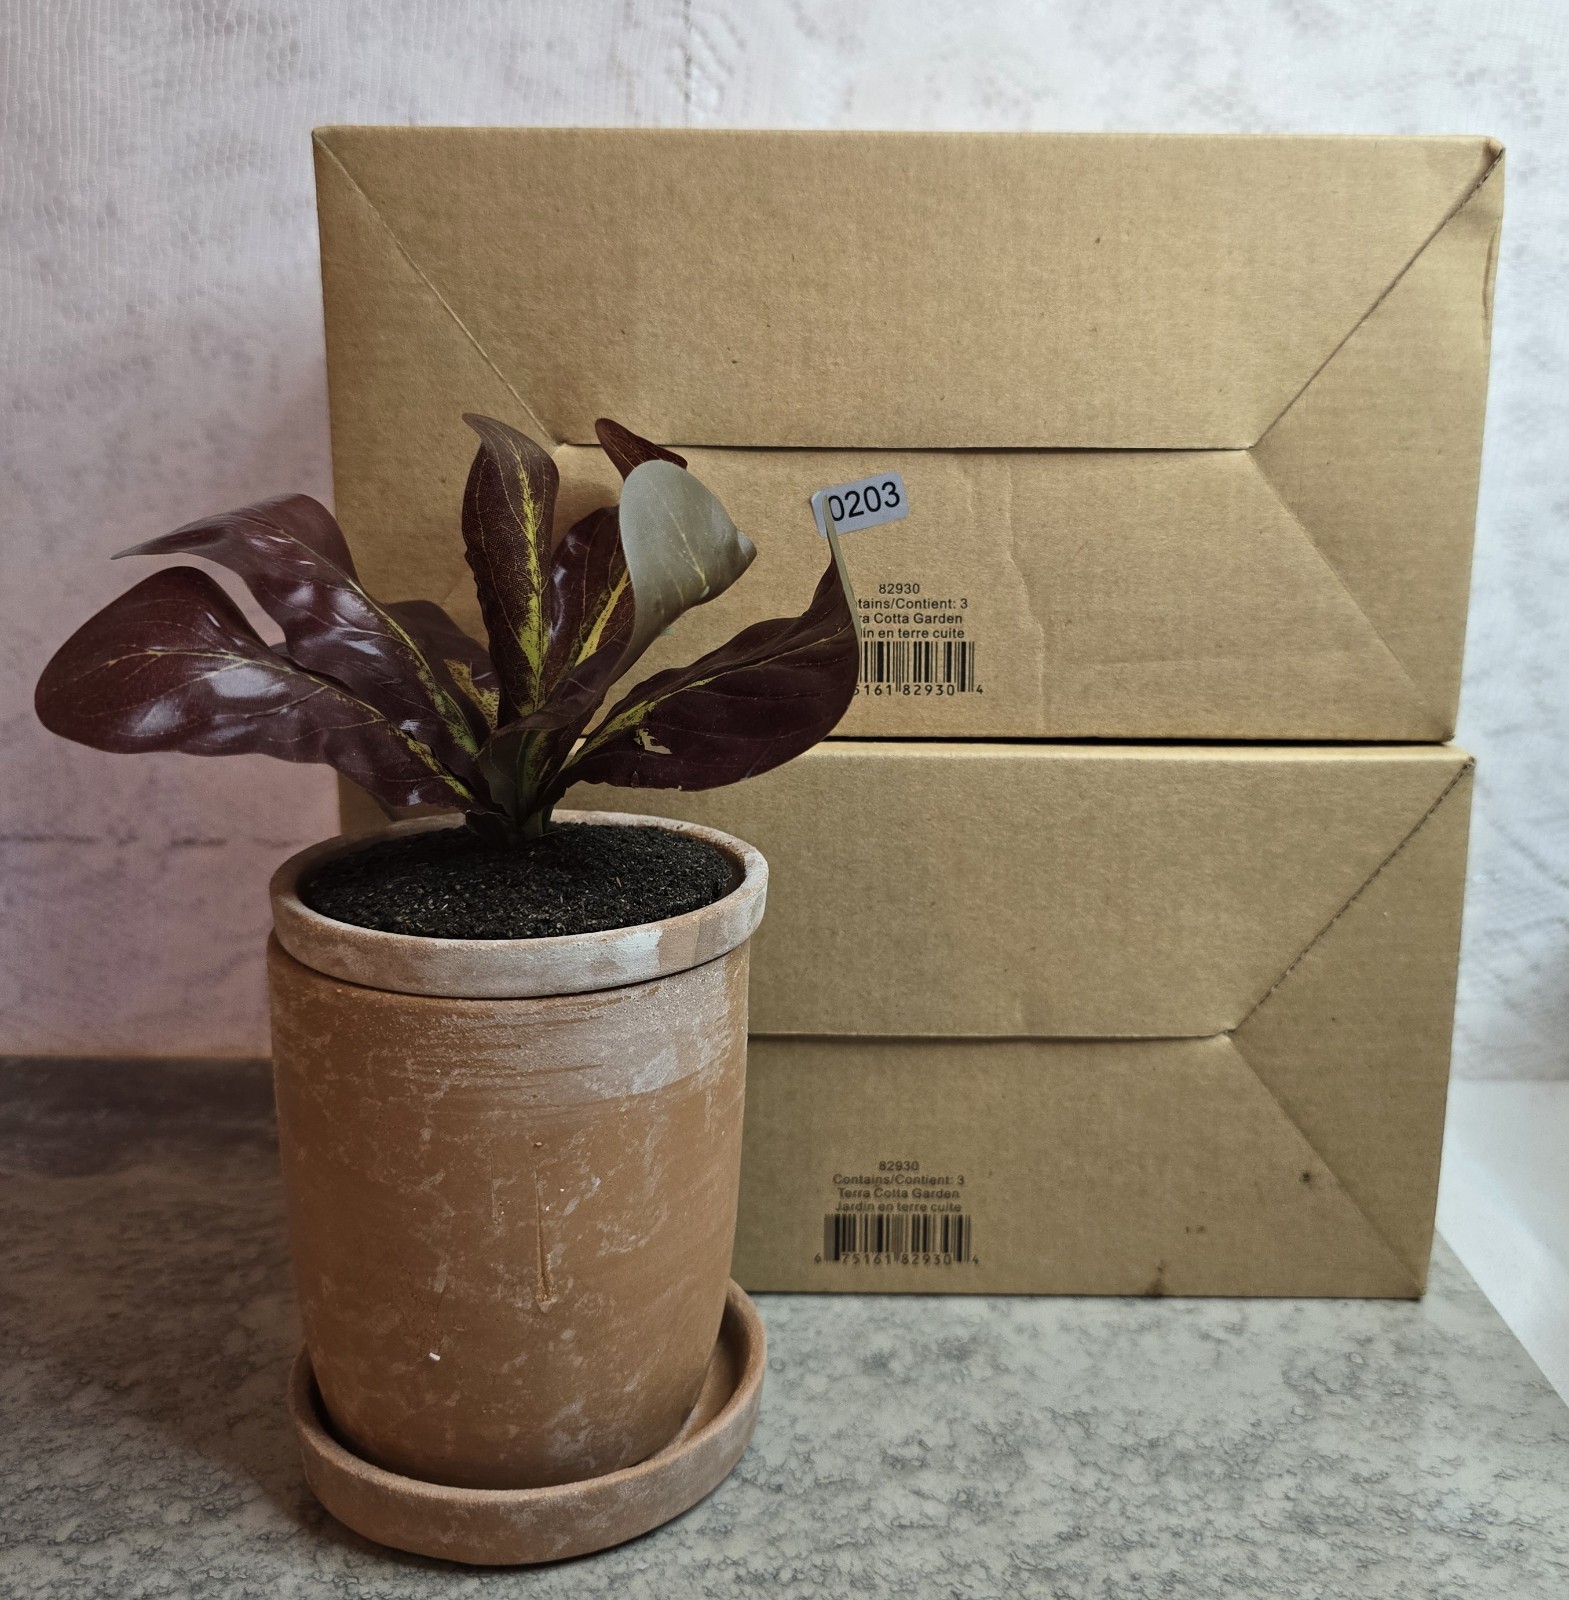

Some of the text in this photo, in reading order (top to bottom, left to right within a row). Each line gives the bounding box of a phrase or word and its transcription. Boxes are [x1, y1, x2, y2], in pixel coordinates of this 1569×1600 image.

[827, 481, 901, 522] 0203
[878, 583, 920, 595] 82930
[855, 598, 968, 610] tains/Contient: 3
[873, 613, 909, 624] Cotta
[913, 613, 963, 624] Garden
[878, 630, 894, 639] en
[898, 627, 930, 639] terre
[932, 627, 965, 639] cuite
[854, 684, 983, 696] 5161 82930 4
[878, 1160, 920, 1171] 82930
[832, 1173, 965, 1185] Contains/Contient: 3
[837, 1187, 960, 1198] Terra Cotta Garden
[835, 1201, 962, 1212] Jardin en terre cuite
[814, 1254, 979, 1265] 6 75161 82930 4
